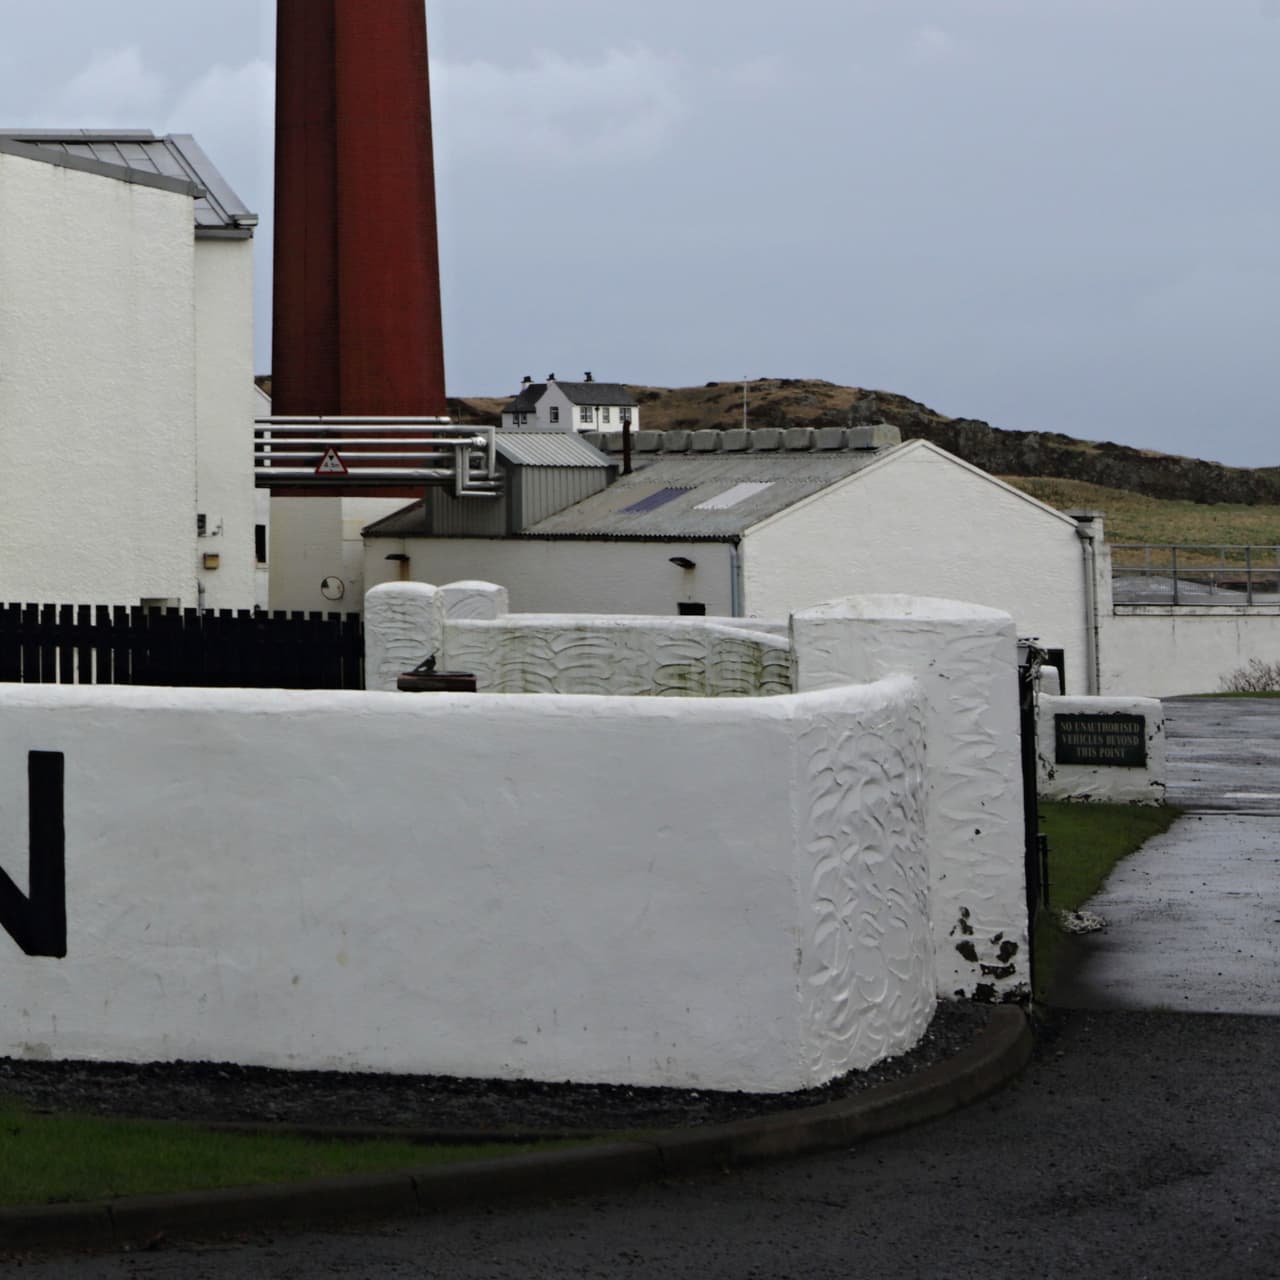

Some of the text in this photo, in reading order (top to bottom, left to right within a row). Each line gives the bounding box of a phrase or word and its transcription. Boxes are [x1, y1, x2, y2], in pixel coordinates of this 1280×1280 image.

[1060, 721, 1139, 732] NO UNAUTHORISED
[1062, 734, 1139, 745] VEHICLES BEYOND
[1076, 747, 1125, 758] THIS POINT
